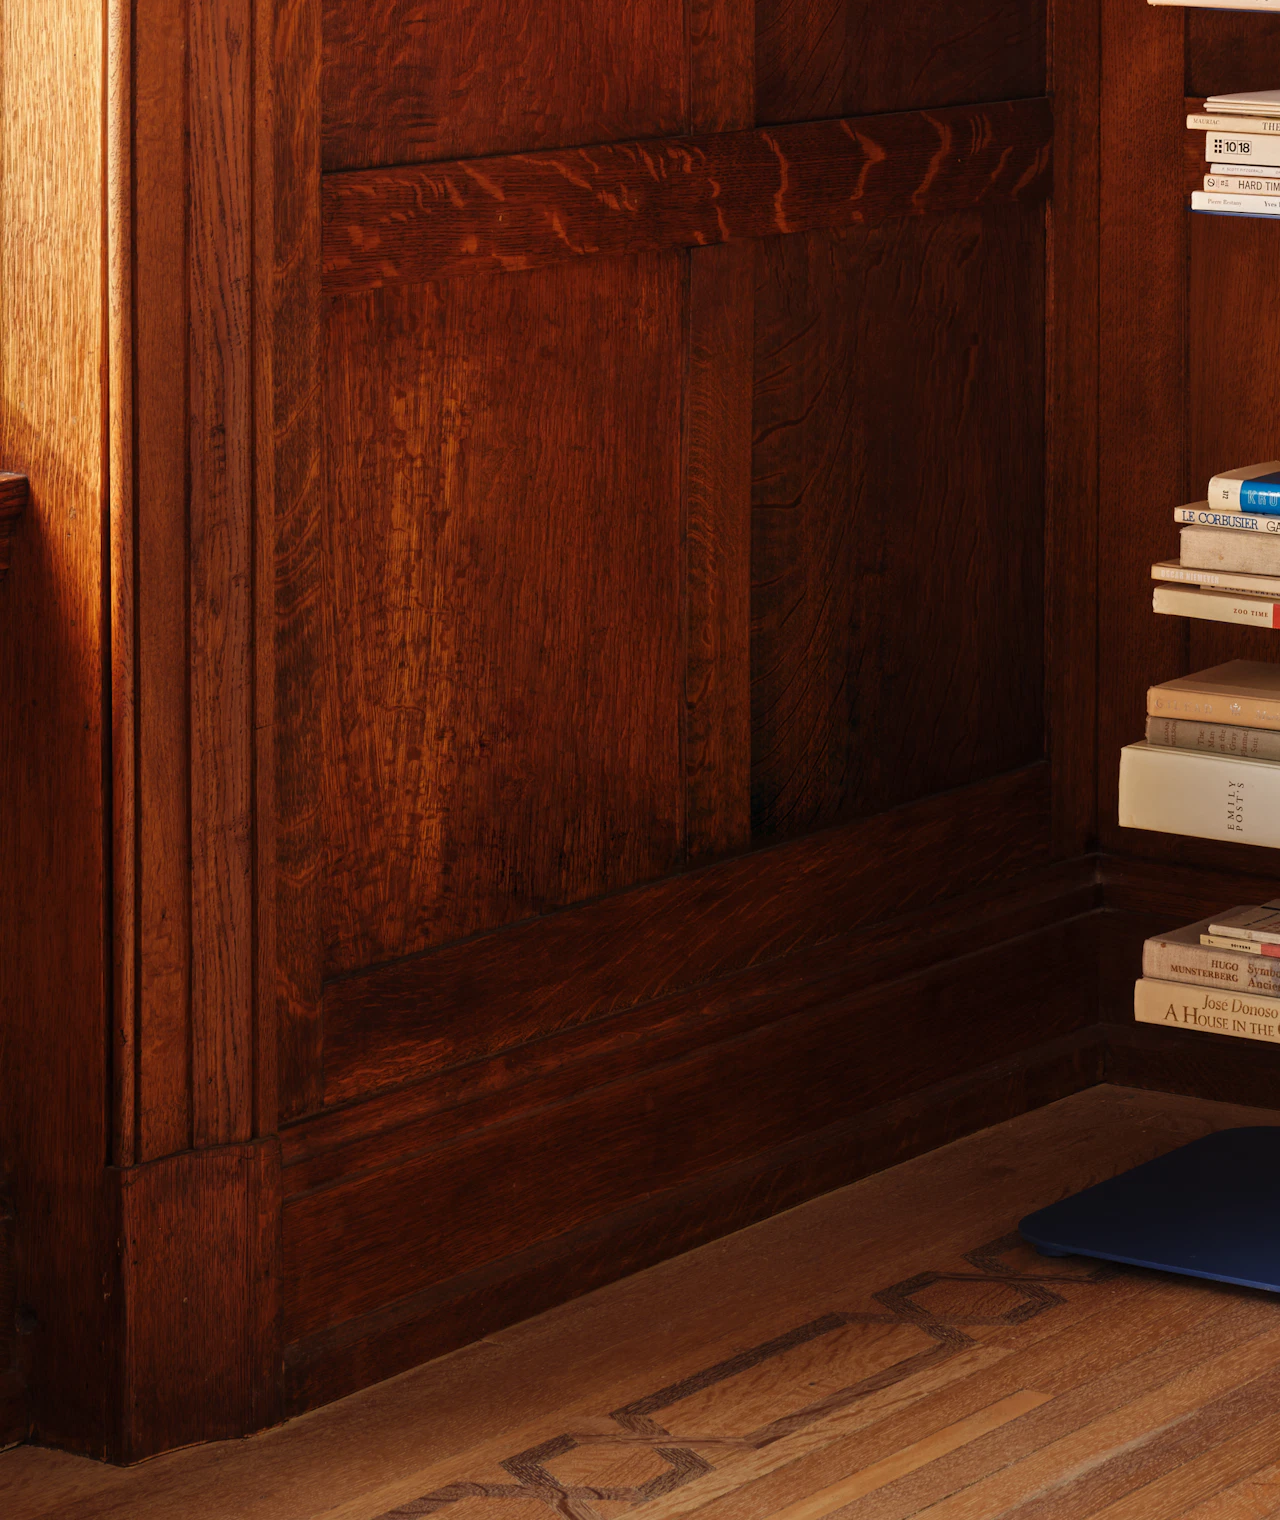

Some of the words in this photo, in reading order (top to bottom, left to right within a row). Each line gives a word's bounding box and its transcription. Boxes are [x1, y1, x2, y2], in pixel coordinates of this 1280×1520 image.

[1238, 180, 1263, 191] HARD
[1264, 200, 1277, 208] Yves
[1181, 510, 1195, 523] LE
[1198, 512, 1259, 530] CORBUSIER
[1160, 569, 1184, 580] OSCAR
[1185, 572, 1220, 585] NIEMEYER
[1250, 610, 1269, 618] TIME
[1155, 699, 1213, 714] GILEAD
[1197, 729, 1205, 745] The
[1219, 729, 1227, 743] the
[1229, 732, 1238, 751] Gray
[1251, 737, 1259, 753] Suit
[1227, 780, 1236, 831] EMILY
[1235, 782, 1245, 832] POST'S
[1211, 959, 1239, 971] HUGO
[1170, 964, 1239, 983] MUNSTERBERG
[1201, 994, 1229, 1012] José
[1232, 999, 1279, 1019] Donoso
[1164, 1003, 1179, 1022] A
[1182, 1005, 1229, 1030] HOUSE
[1232, 1019, 1247, 1032] IN
[1249, 1022, 1275, 1037] THE
